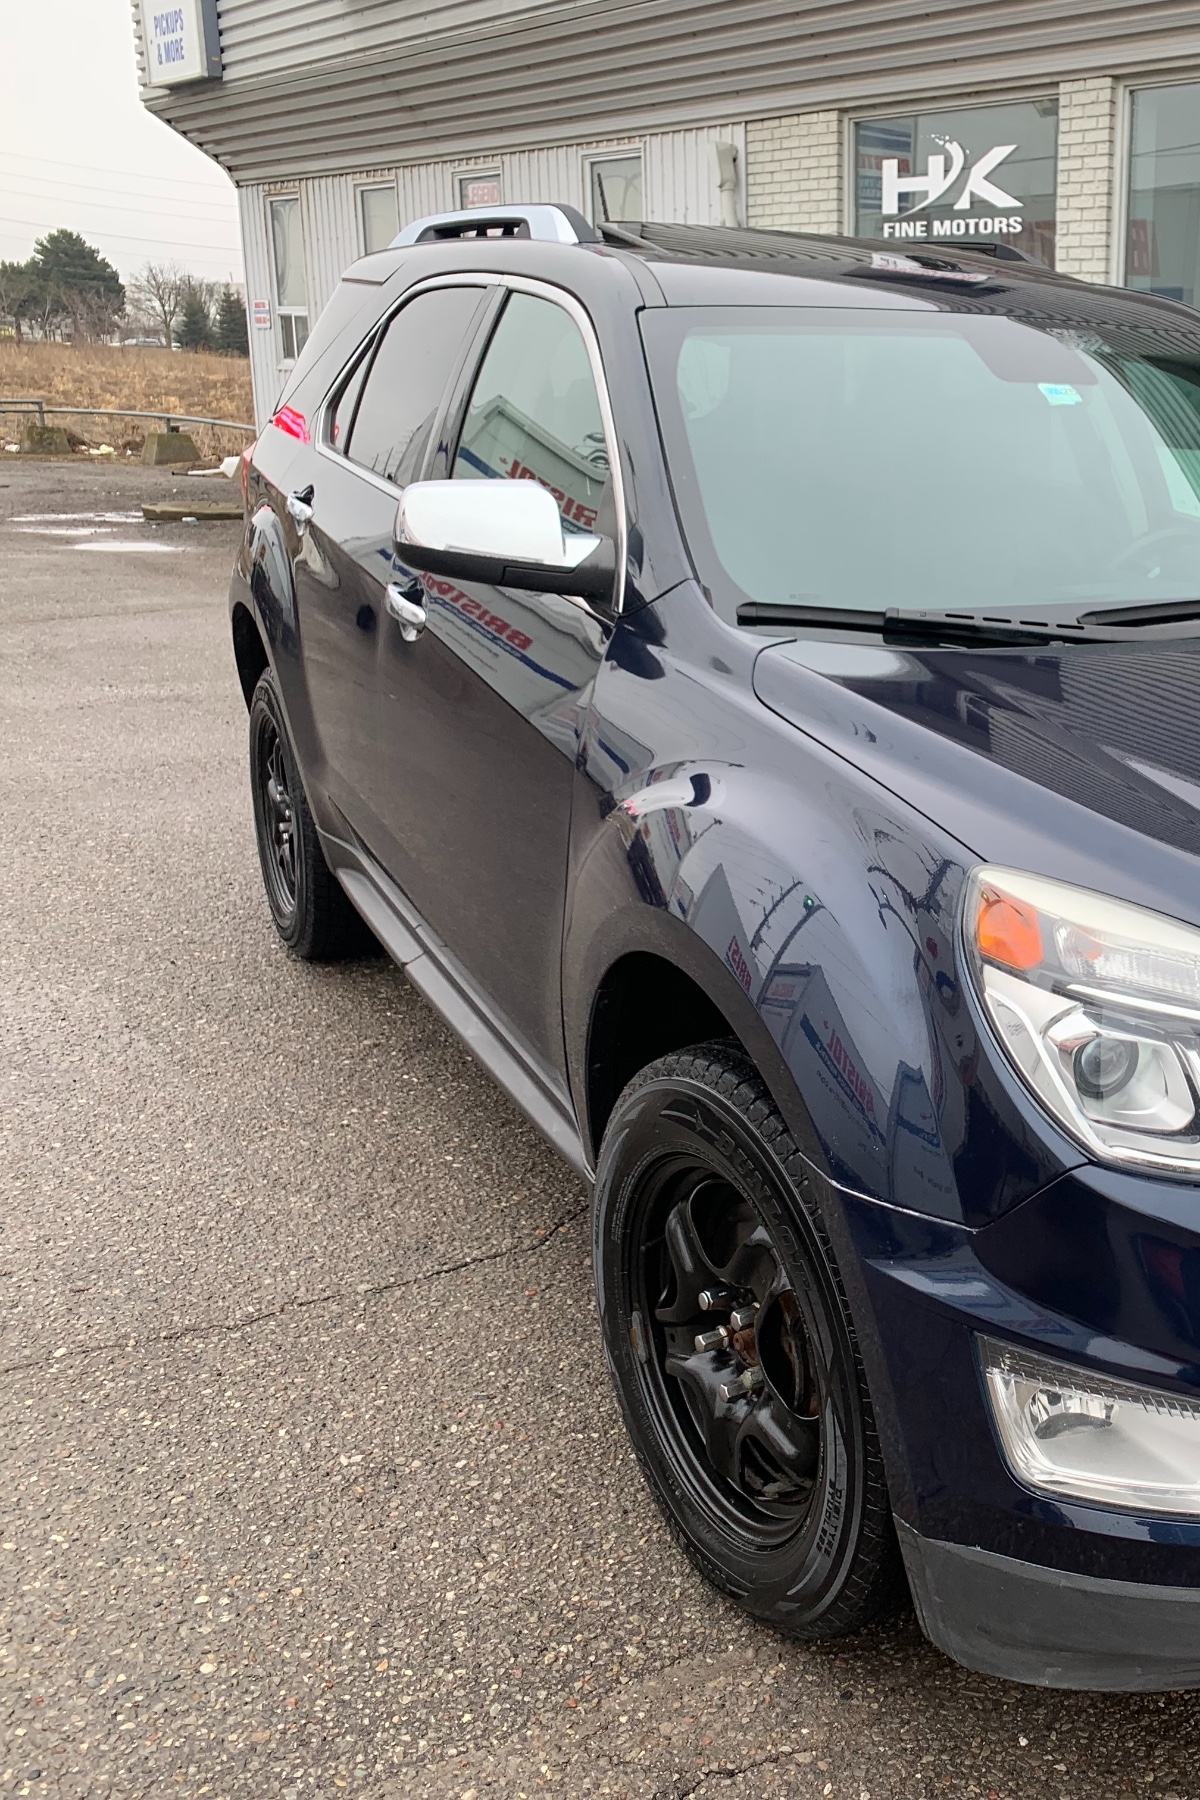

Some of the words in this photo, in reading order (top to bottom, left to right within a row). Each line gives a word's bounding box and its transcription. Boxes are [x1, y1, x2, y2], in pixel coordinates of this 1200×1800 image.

[153, 8, 184, 37] PICKUPS
[157, 43, 163, 66] &
[164, 38, 185, 63] MORE
[883, 221, 928, 238] FINE
[933, 216, 1023, 236] MOTORS
[714, 1129, 813, 1291] DUNLOP
